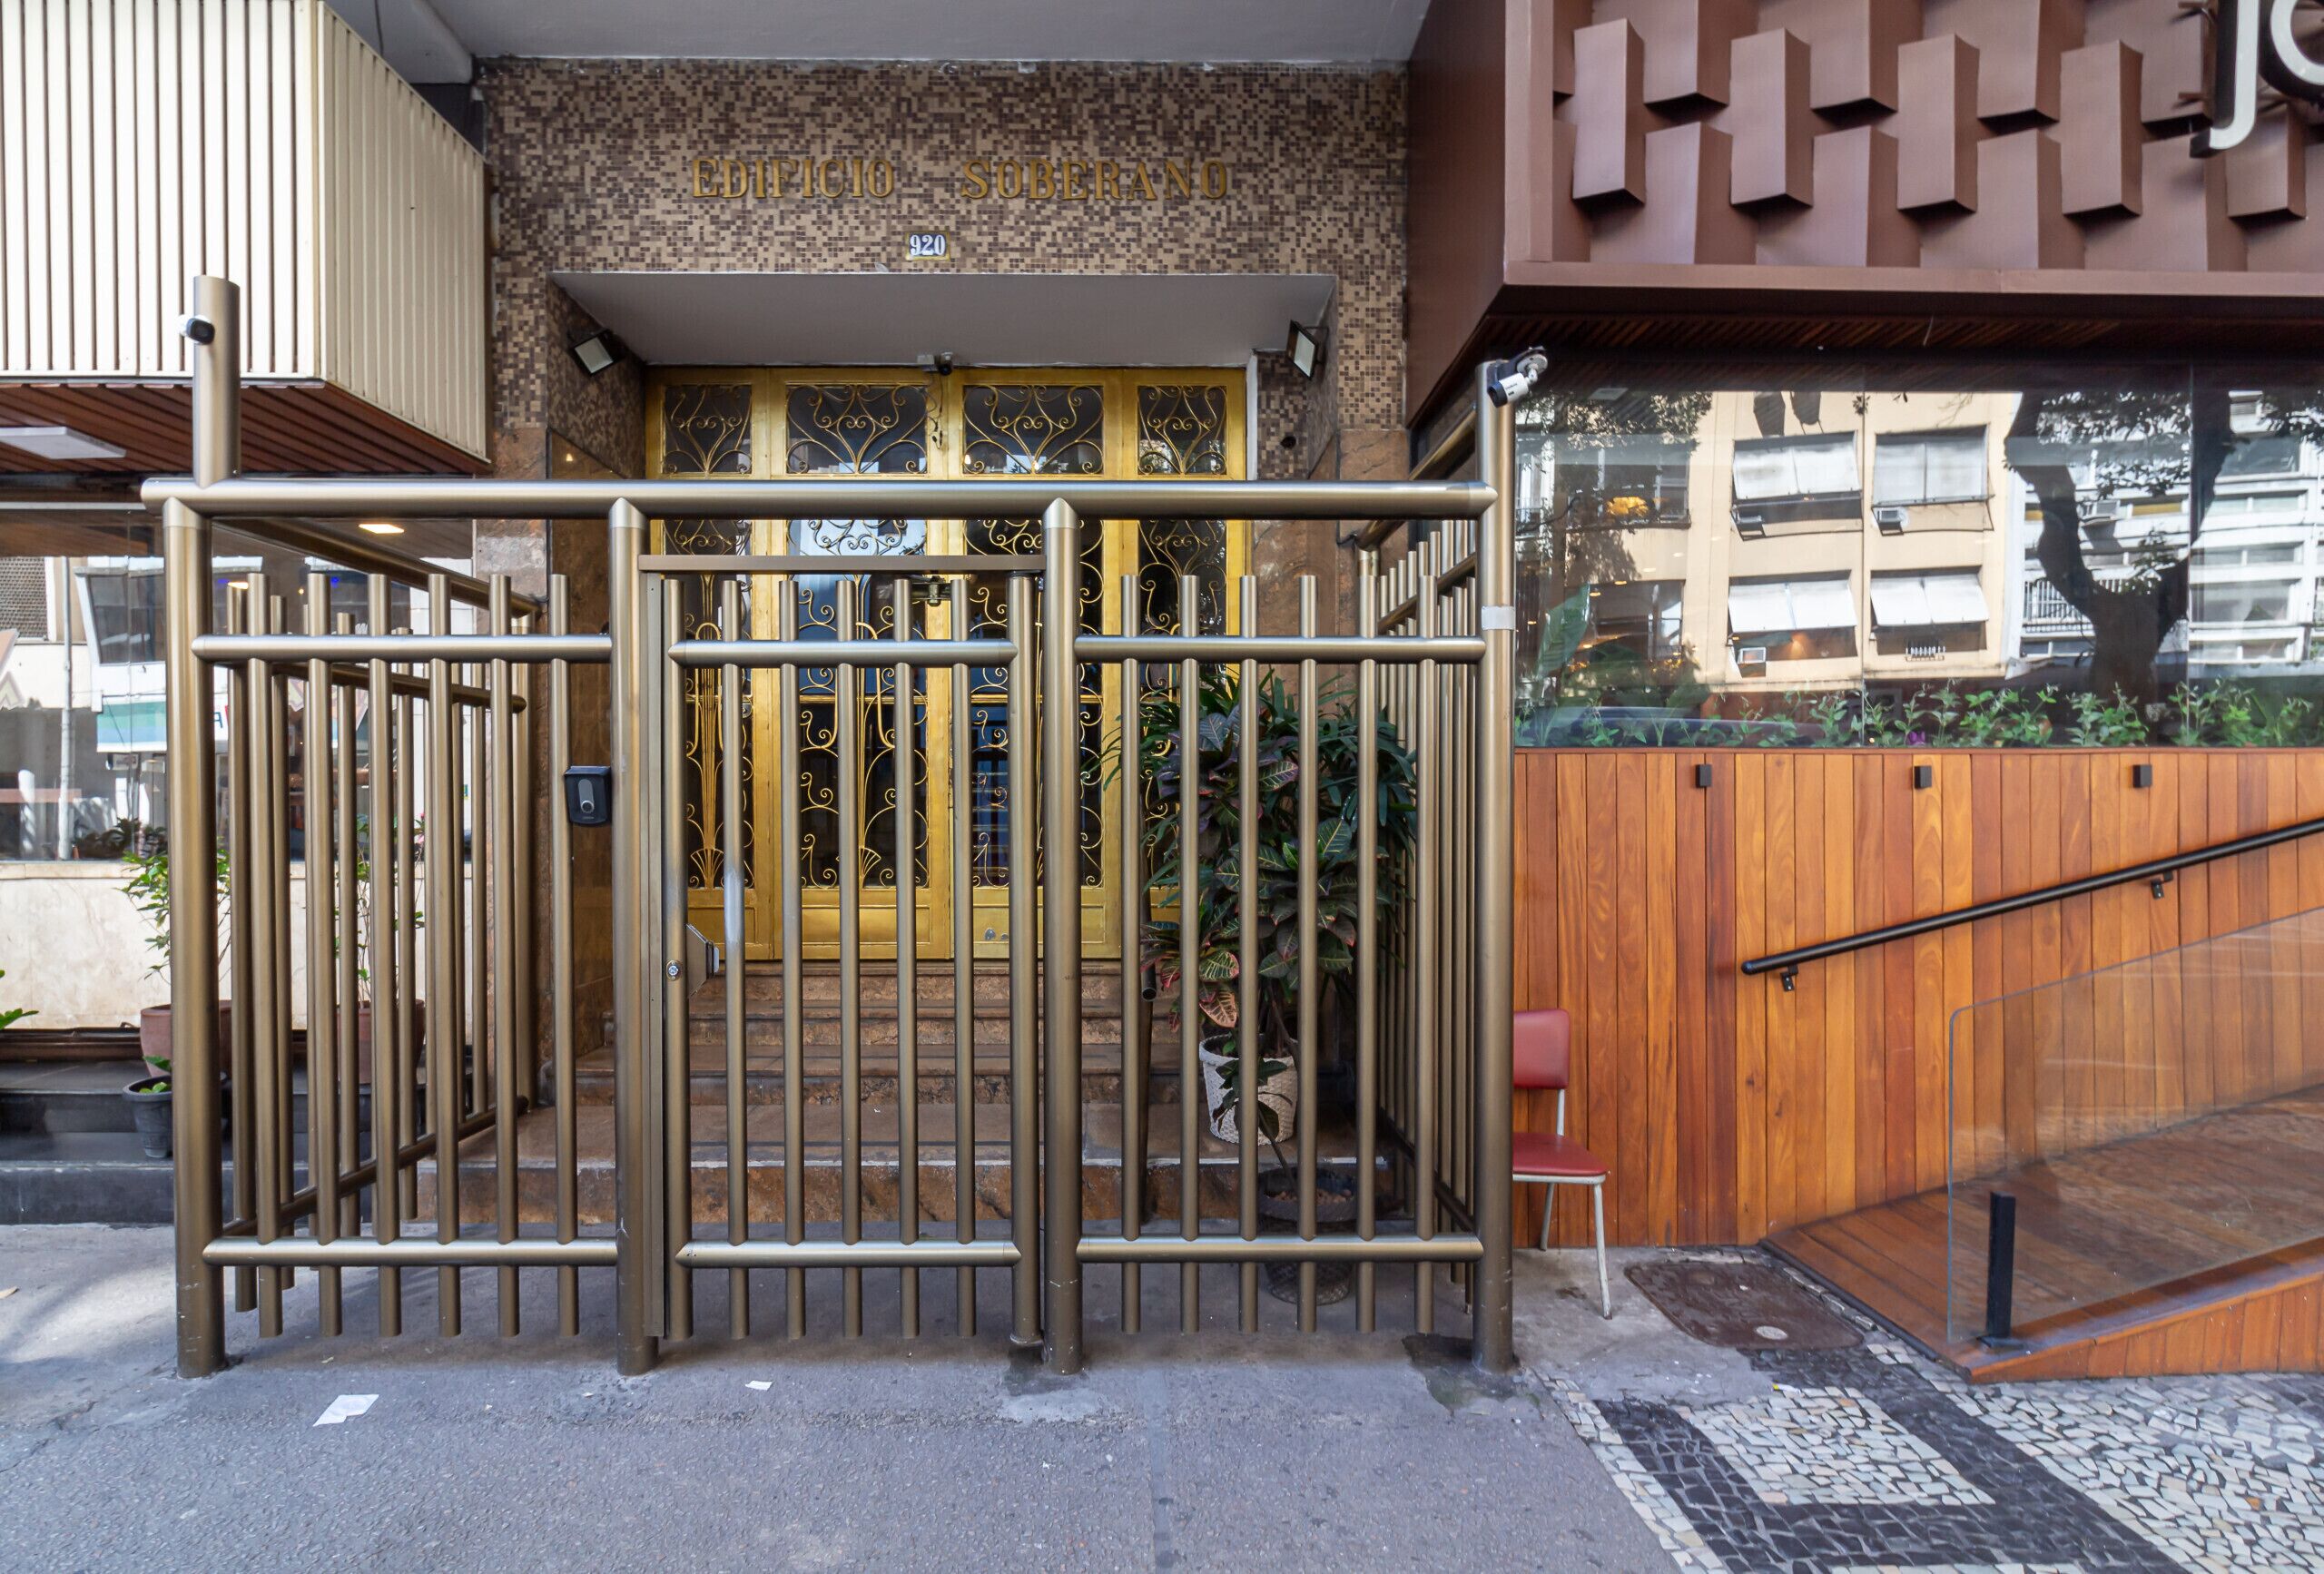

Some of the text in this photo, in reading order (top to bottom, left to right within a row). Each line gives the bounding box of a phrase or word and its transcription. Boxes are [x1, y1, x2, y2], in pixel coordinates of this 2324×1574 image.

[692, 158, 1227, 201] EDIFICIO SOBERANO
[910, 234, 946, 256] 920
